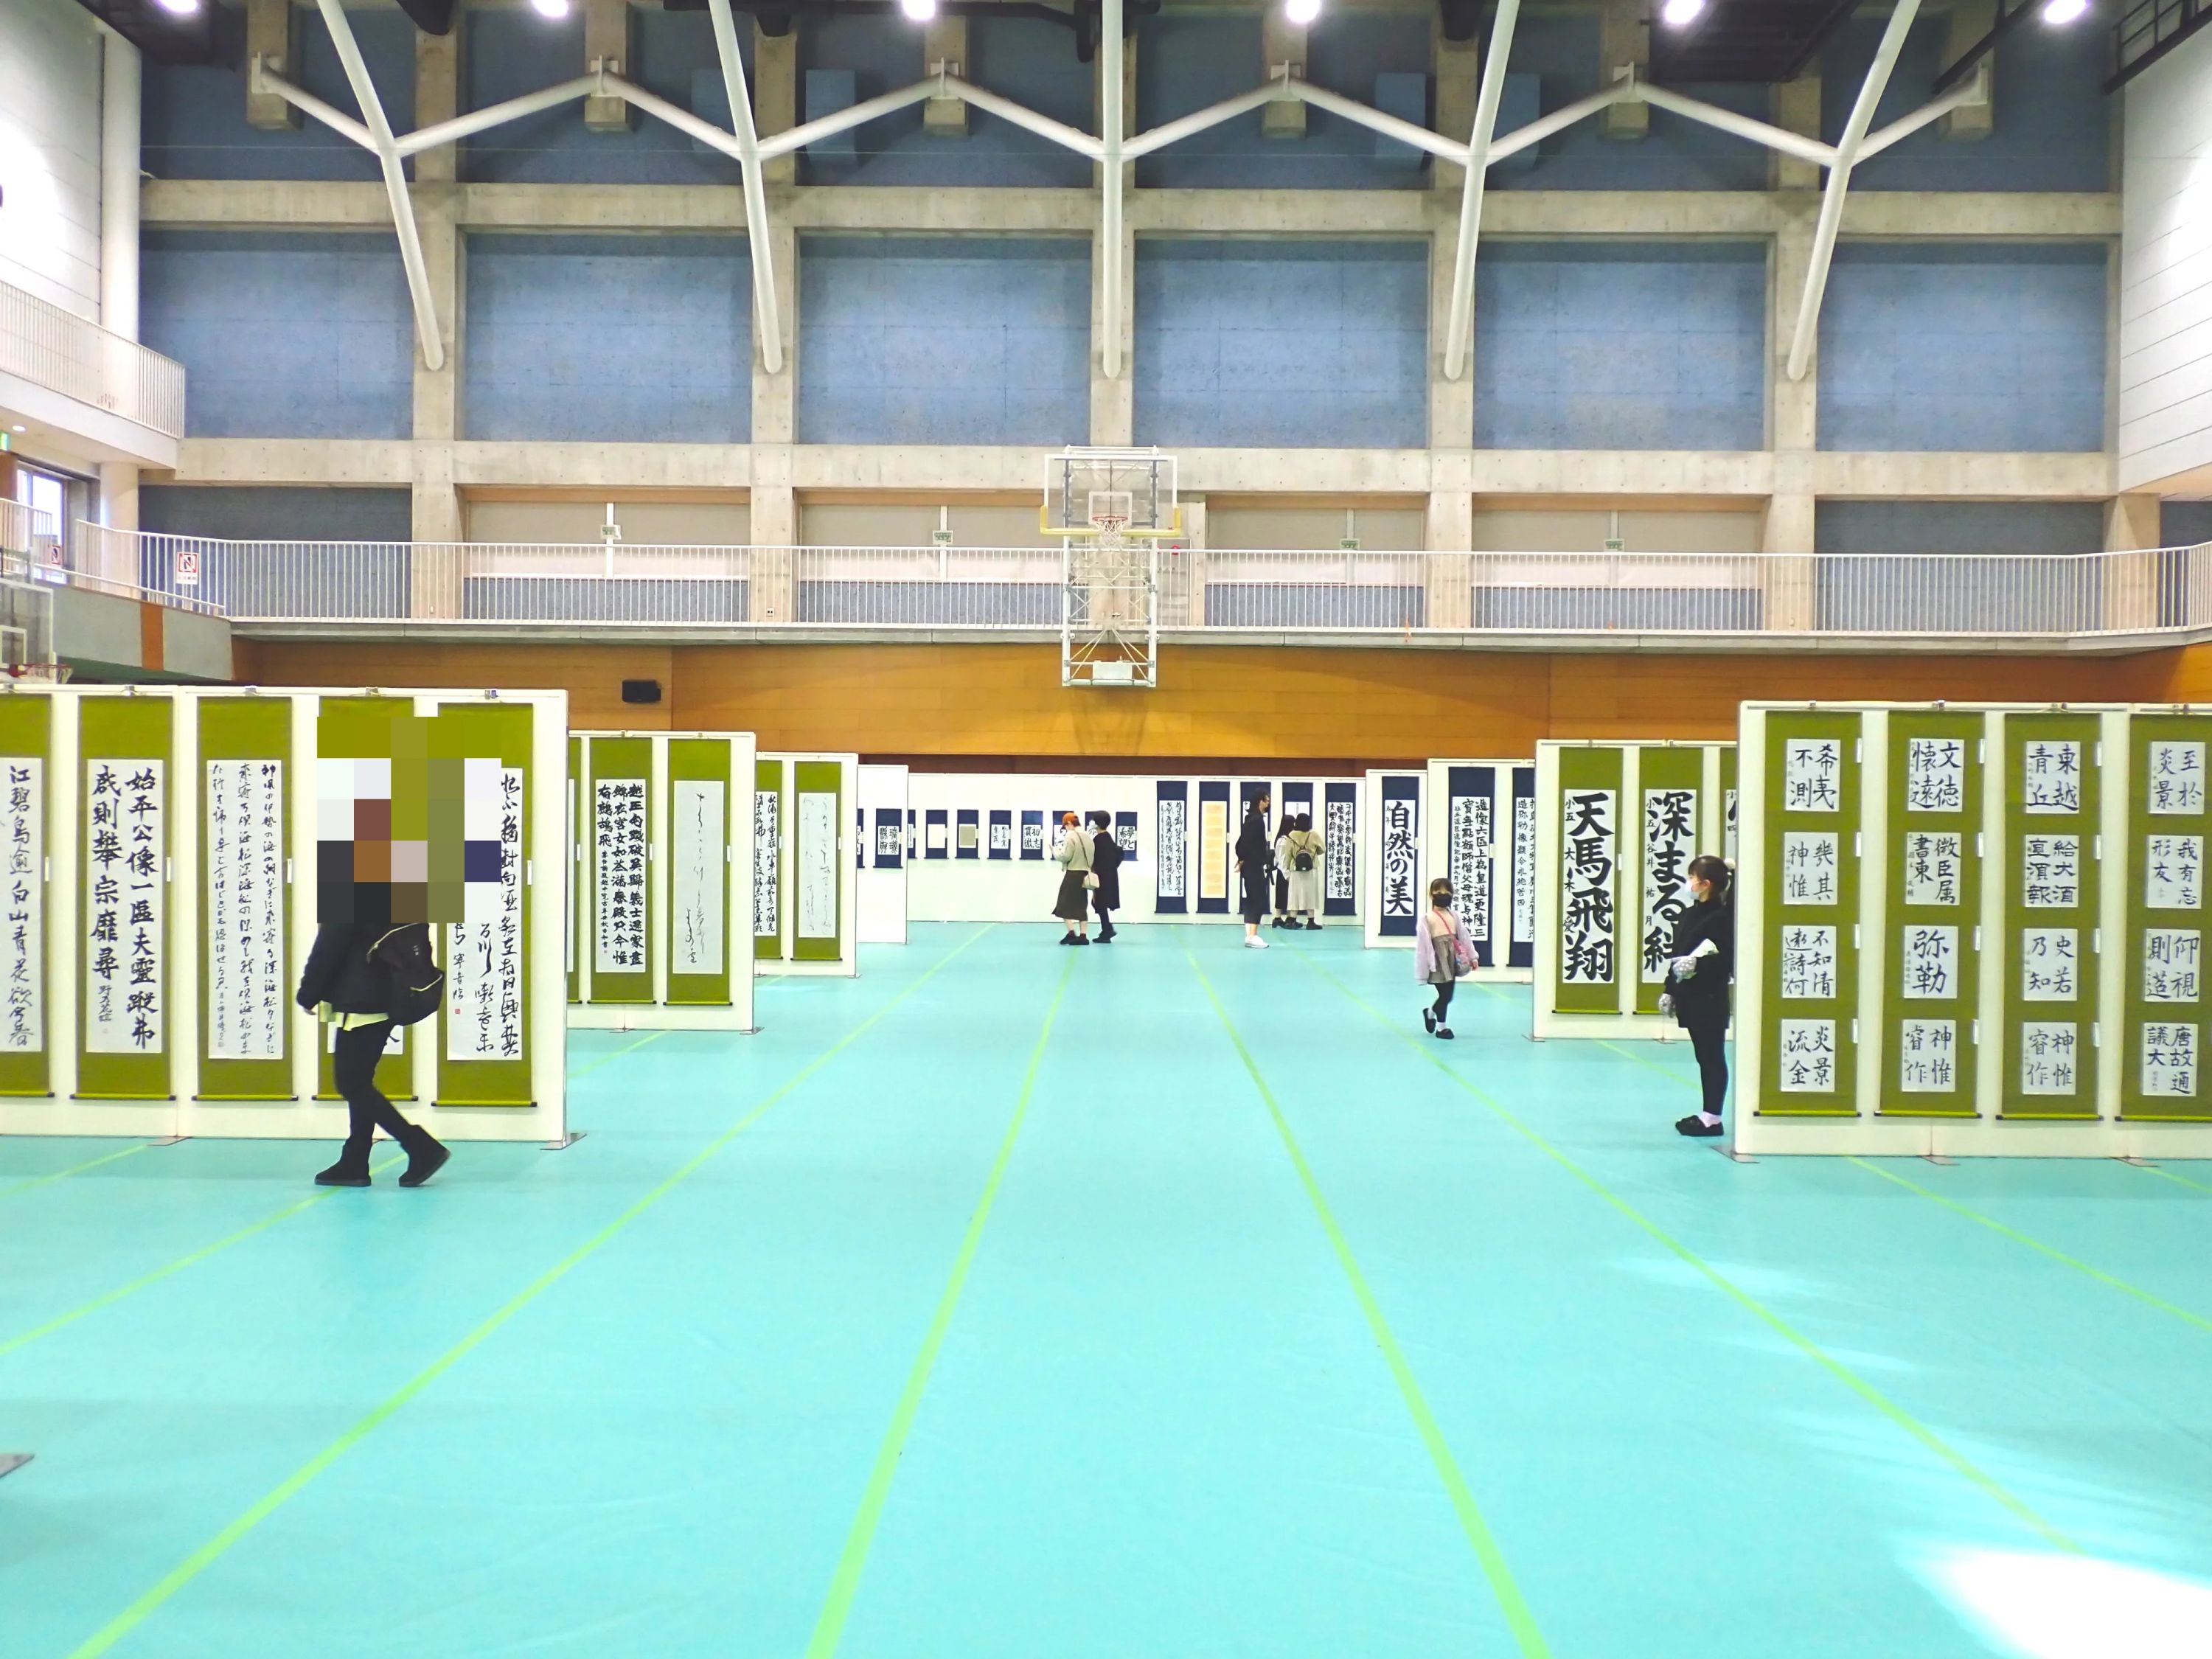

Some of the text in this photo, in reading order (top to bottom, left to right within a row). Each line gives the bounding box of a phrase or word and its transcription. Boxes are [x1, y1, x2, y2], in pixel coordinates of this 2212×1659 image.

[1791, 750, 1812, 807] 不測
[1813, 744, 1837, 809] 希夷
[2026, 744, 2053, 806] 青丘
[2052, 744, 2079, 811] 東越
[2155, 748, 2176, 809] 炎景
[1565, 799, 1576, 821] 小五
[1385, 800, 1416, 915] 自然の美
[1789, 842, 1809, 897] 神惟
[1913, 835, 1933, 883] 書東
[2152, 840, 2172, 882] 形友
[2177, 838, 2197, 905] 我有忘
[1565, 793, 1615, 983] 天馬飛翔
[1913, 930, 1949, 993] 弥勒
[2029, 937, 2051, 990] 乃知
[2053, 936, 2074, 992] 史若
[2171, 936, 2201, 998] 仰視
[1789, 1031, 1811, 1084] 流金
[1812, 1026, 1833, 1085] 炎景
[1930, 1026, 1952, 1085] 神惟
[2052, 1030, 2074, 1086] 神惟
[2147, 1026, 2169, 1065] 議大
[2170, 1026, 2193, 1094] 唐故通
